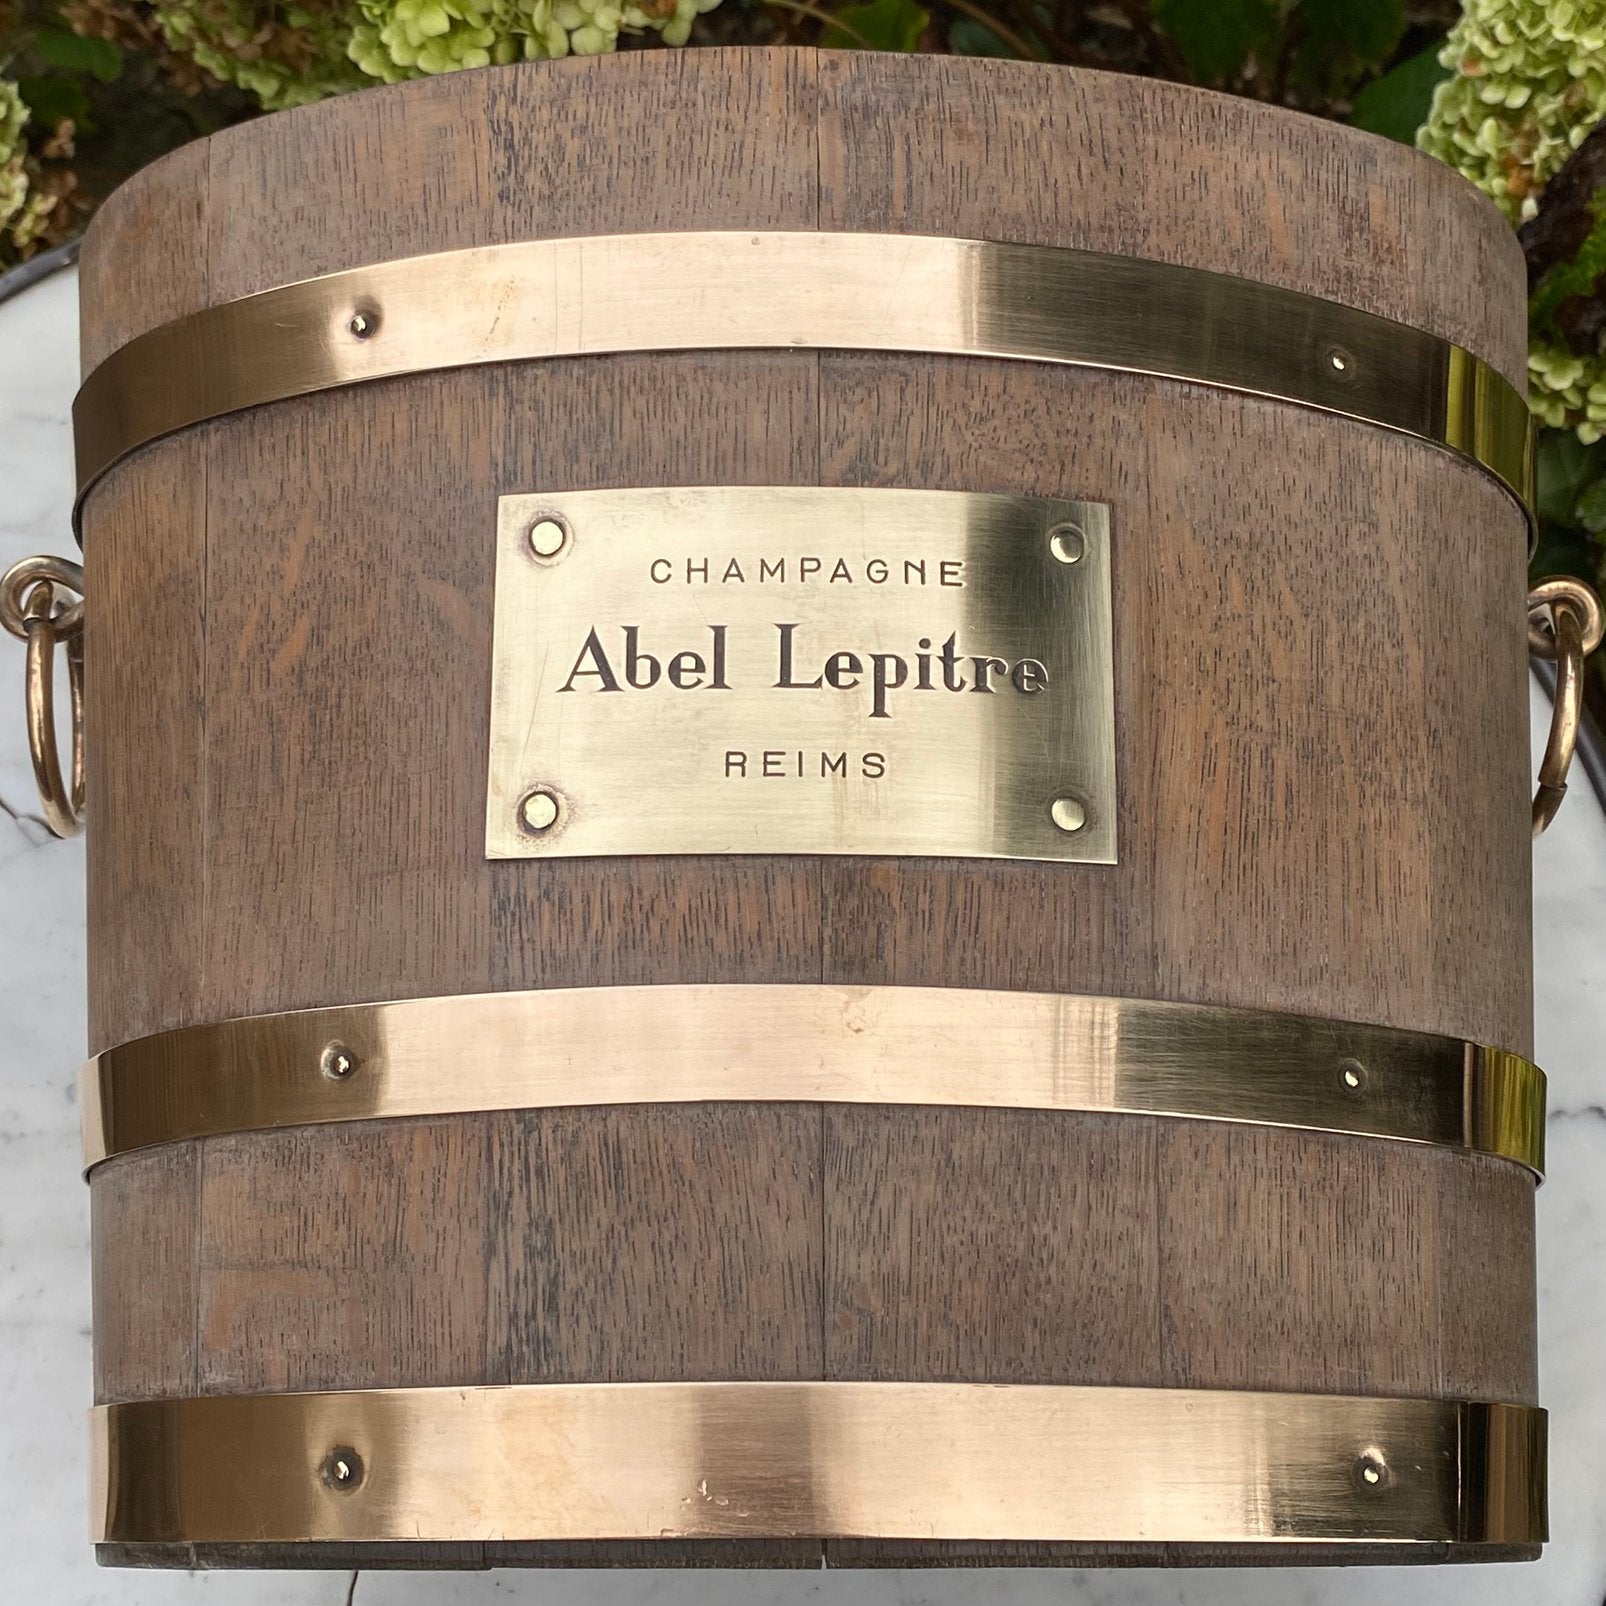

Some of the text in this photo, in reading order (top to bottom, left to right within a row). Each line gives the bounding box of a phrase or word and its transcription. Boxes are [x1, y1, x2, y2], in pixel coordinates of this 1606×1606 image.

[650, 557, 966, 588] CHAMPAGNE
[556, 623, 1050, 719] Abel Lepitre
[725, 750, 888, 780] REIMS
